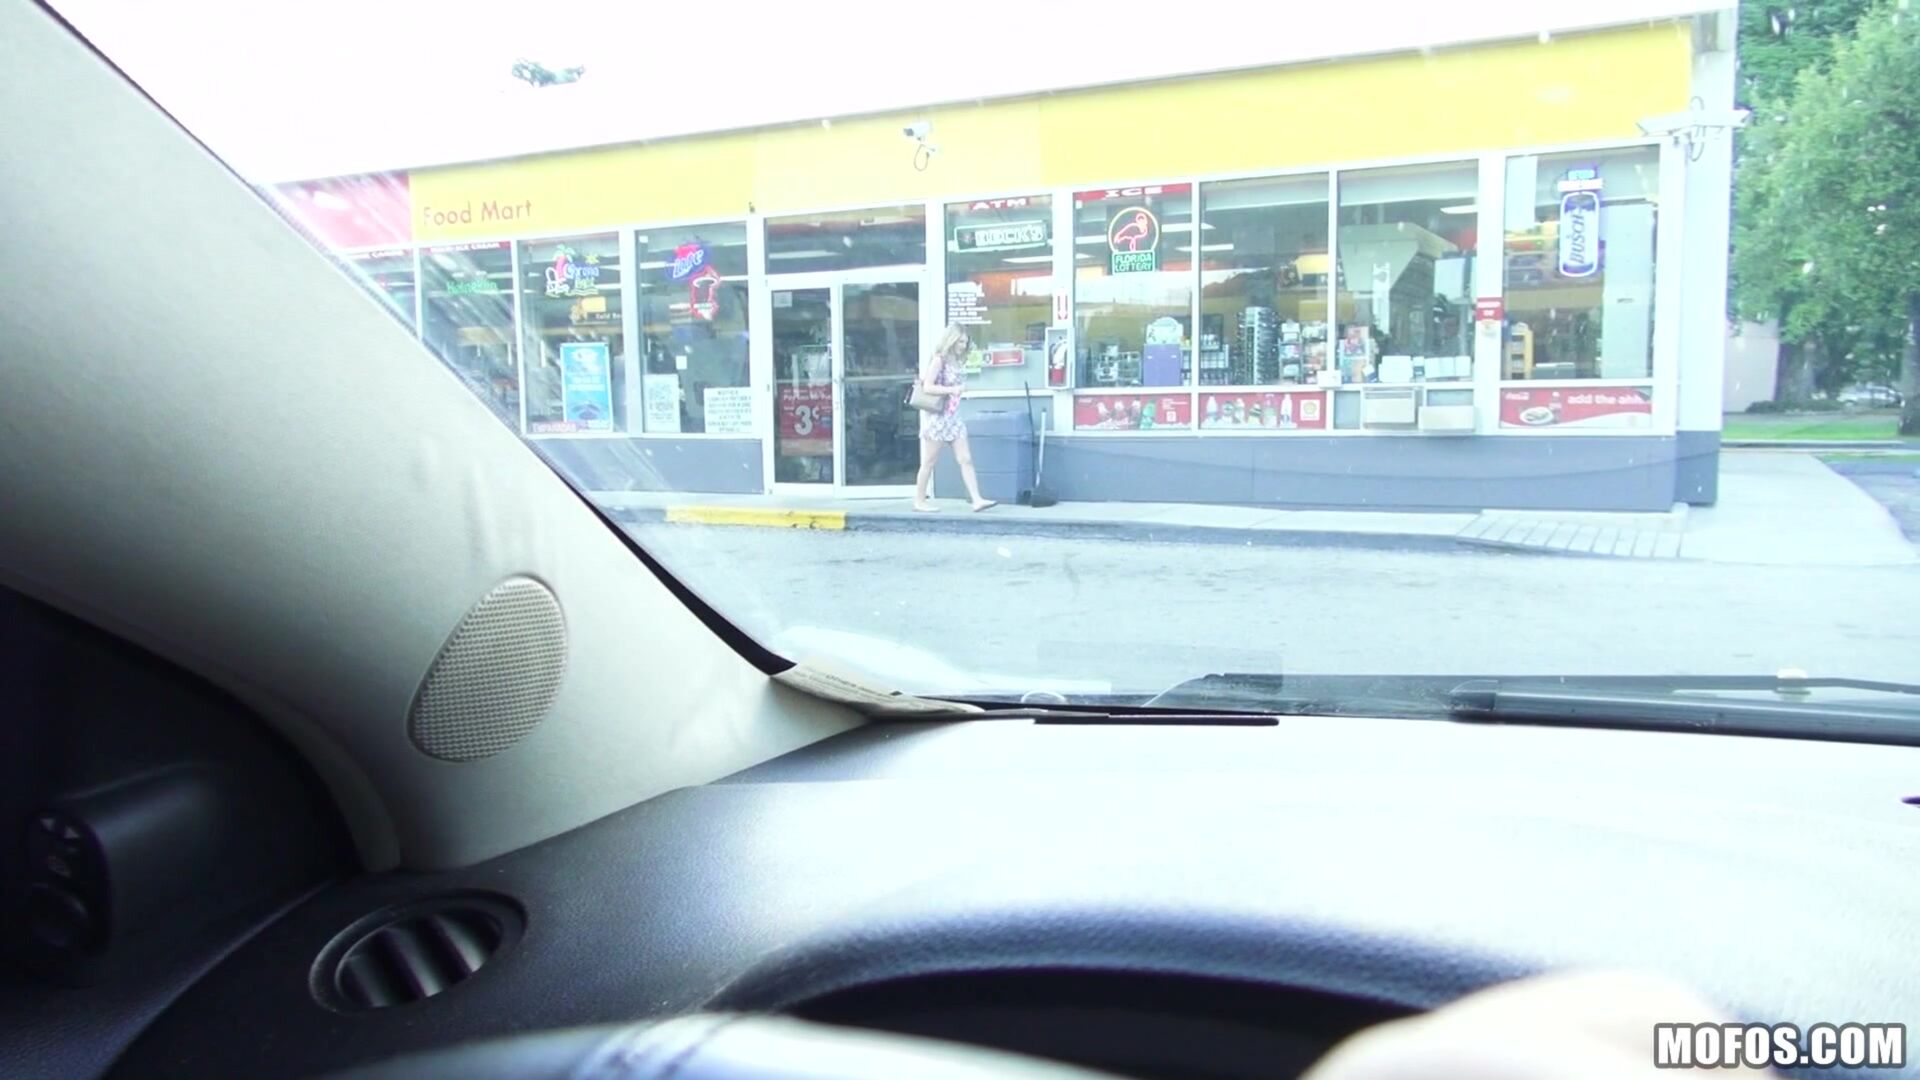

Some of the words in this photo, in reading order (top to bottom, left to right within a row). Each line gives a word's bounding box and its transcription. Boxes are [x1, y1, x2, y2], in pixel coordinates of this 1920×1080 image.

[1105, 186, 1162, 198] ICE
[973, 199, 1027, 211] ATM
[423, 200, 472, 226] Food
[481, 199, 532, 222] Mart
[1569, 213, 1585, 265] BUSCH
[1115, 253, 1153, 264] FLORIDA
[1115, 262, 1153, 273] LOTTERY
[1567, 393, 1593, 405] add
[1595, 393, 1616, 405] the
